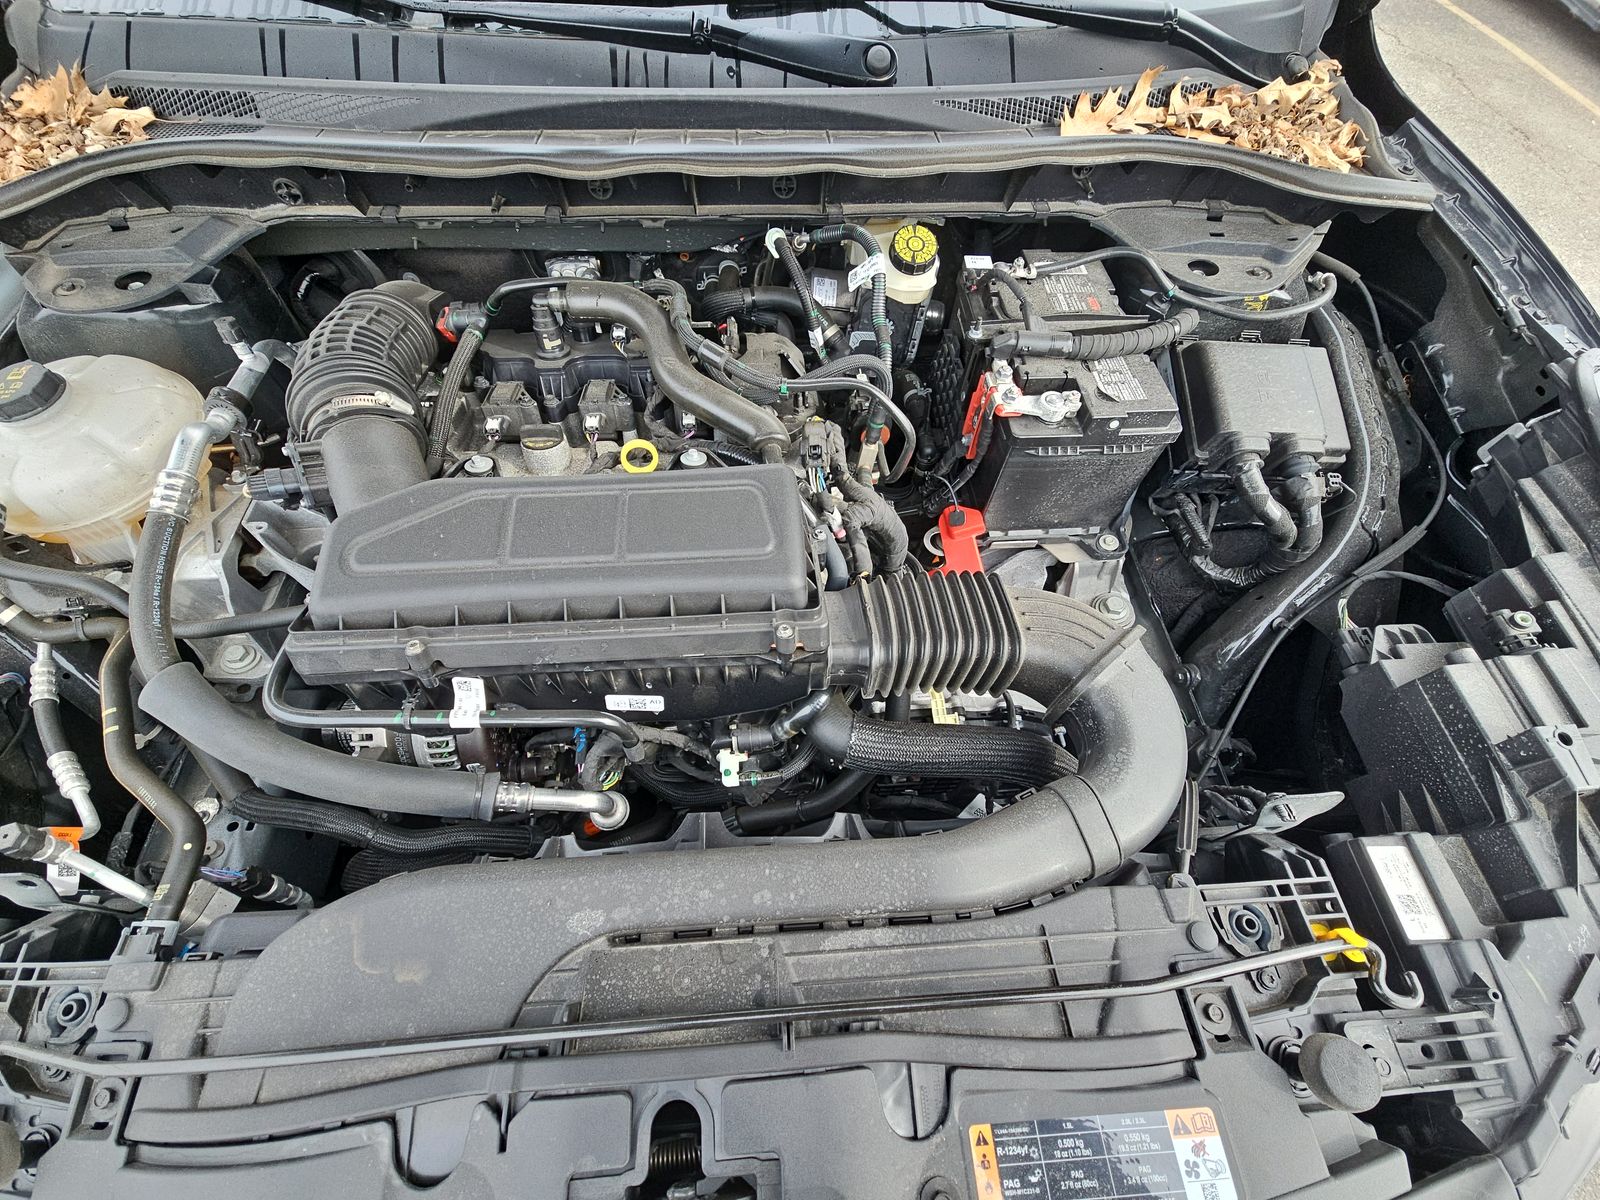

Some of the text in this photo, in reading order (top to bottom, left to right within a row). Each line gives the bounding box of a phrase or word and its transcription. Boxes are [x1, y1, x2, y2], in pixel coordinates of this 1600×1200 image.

[161, 527, 173, 556] SUCTION
[156, 556, 166, 574] HOSE
[1141, 1132, 1151, 1142] kg
[1057, 1138, 1085, 1149] 0.500 kg
[996, 1145, 1029, 1157] R-1234yf
[1138, 1165, 1152, 1173] PAG
[1070, 1170, 1084, 1179] PAG
[1003, 1179, 1021, 1189] PAG
